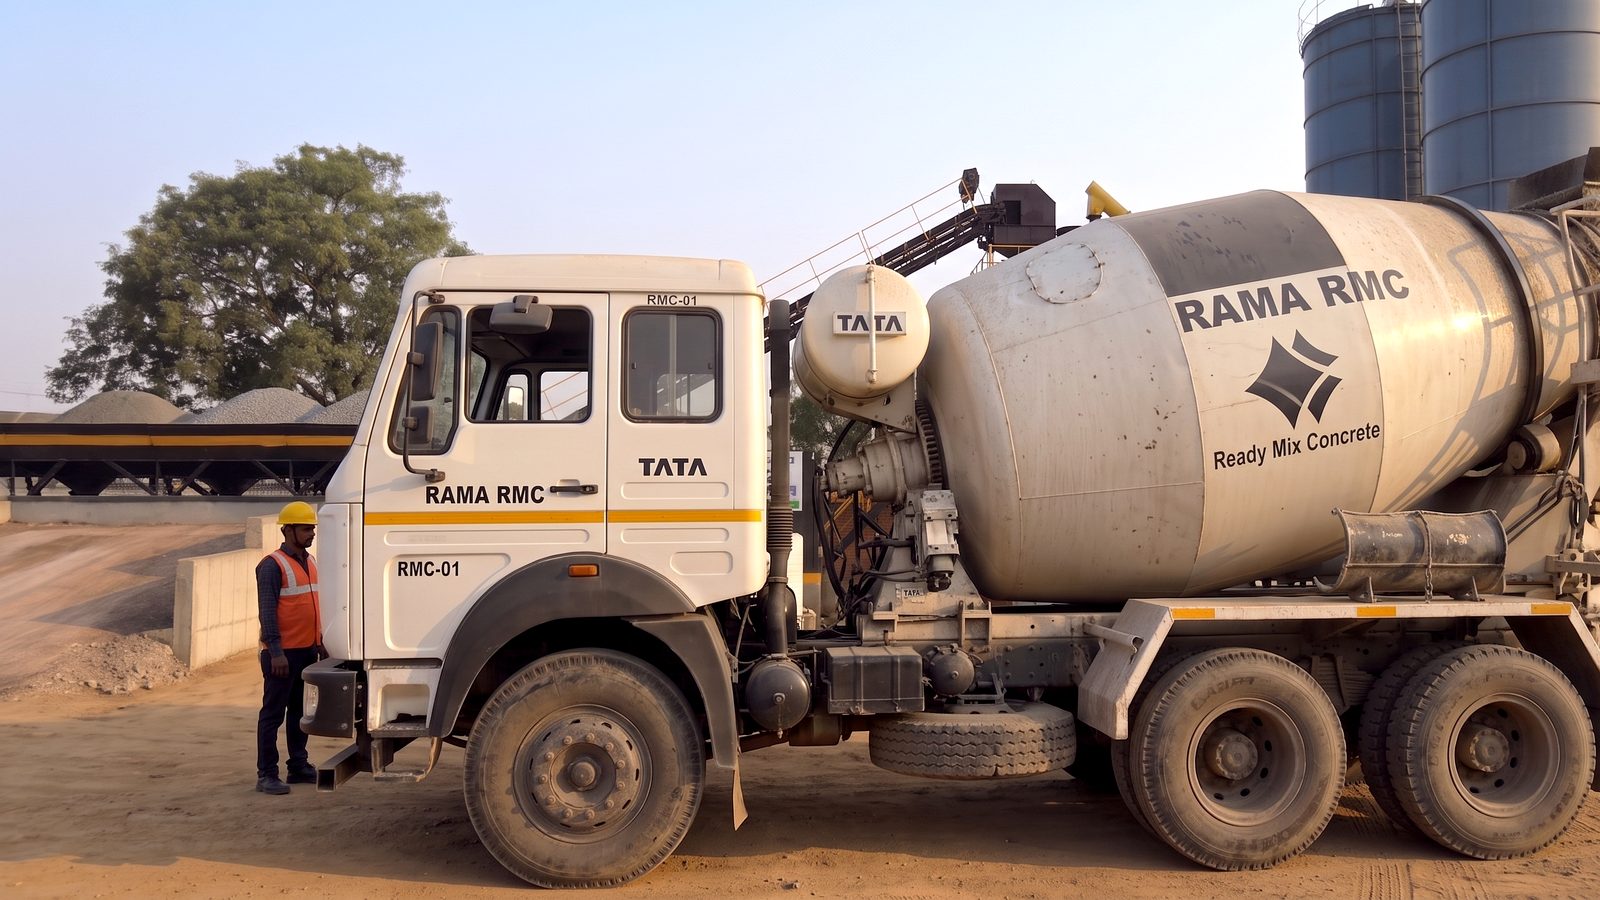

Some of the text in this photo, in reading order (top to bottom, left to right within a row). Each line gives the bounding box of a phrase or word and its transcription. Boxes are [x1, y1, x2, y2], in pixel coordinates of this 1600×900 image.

[647, 294, 697, 306] RMC-01
[1174, 269, 1410, 333] RAMA RMC
[837, 314, 903, 331] TATA
[1214, 422, 1381, 470] Ready Mix Concrete
[638, 458, 708, 476] TATA
[425, 486, 545, 504] RAMA RMC
[397, 561, 460, 577] RMC-01
